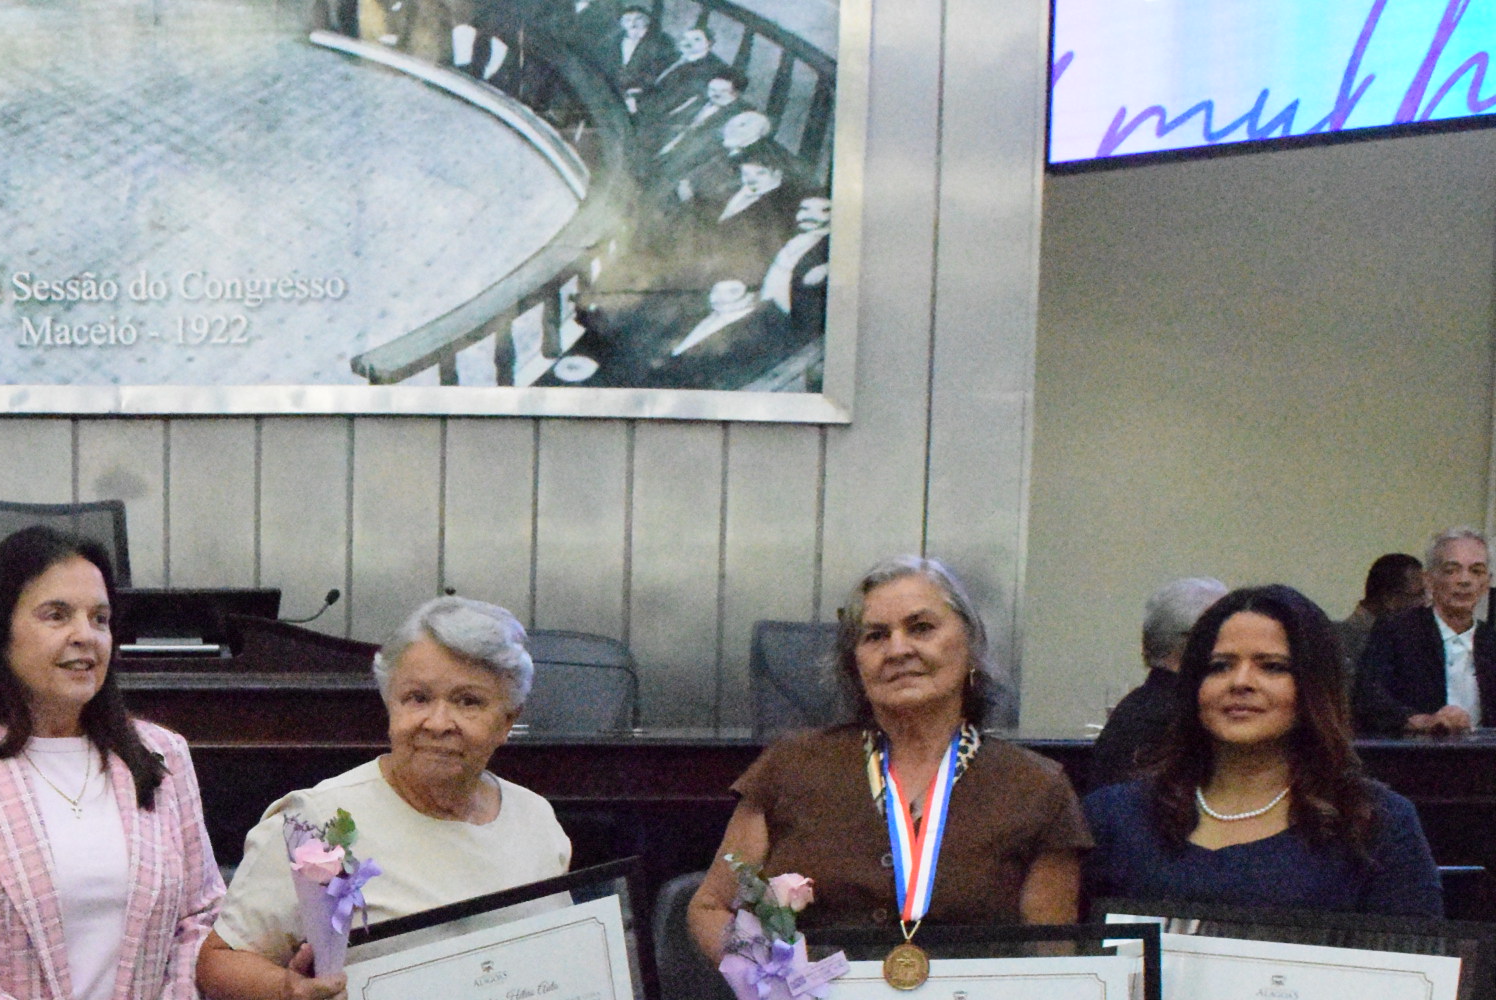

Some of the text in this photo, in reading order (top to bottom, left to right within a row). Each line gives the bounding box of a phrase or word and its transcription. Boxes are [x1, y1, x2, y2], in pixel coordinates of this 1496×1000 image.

[12, 271, 119, 302] Sessão
[129, 271, 168, 302] do
[177, 271, 346, 306] Congresso
[20, 314, 138, 347] Maceió
[176, 314, 251, 345] 1922
